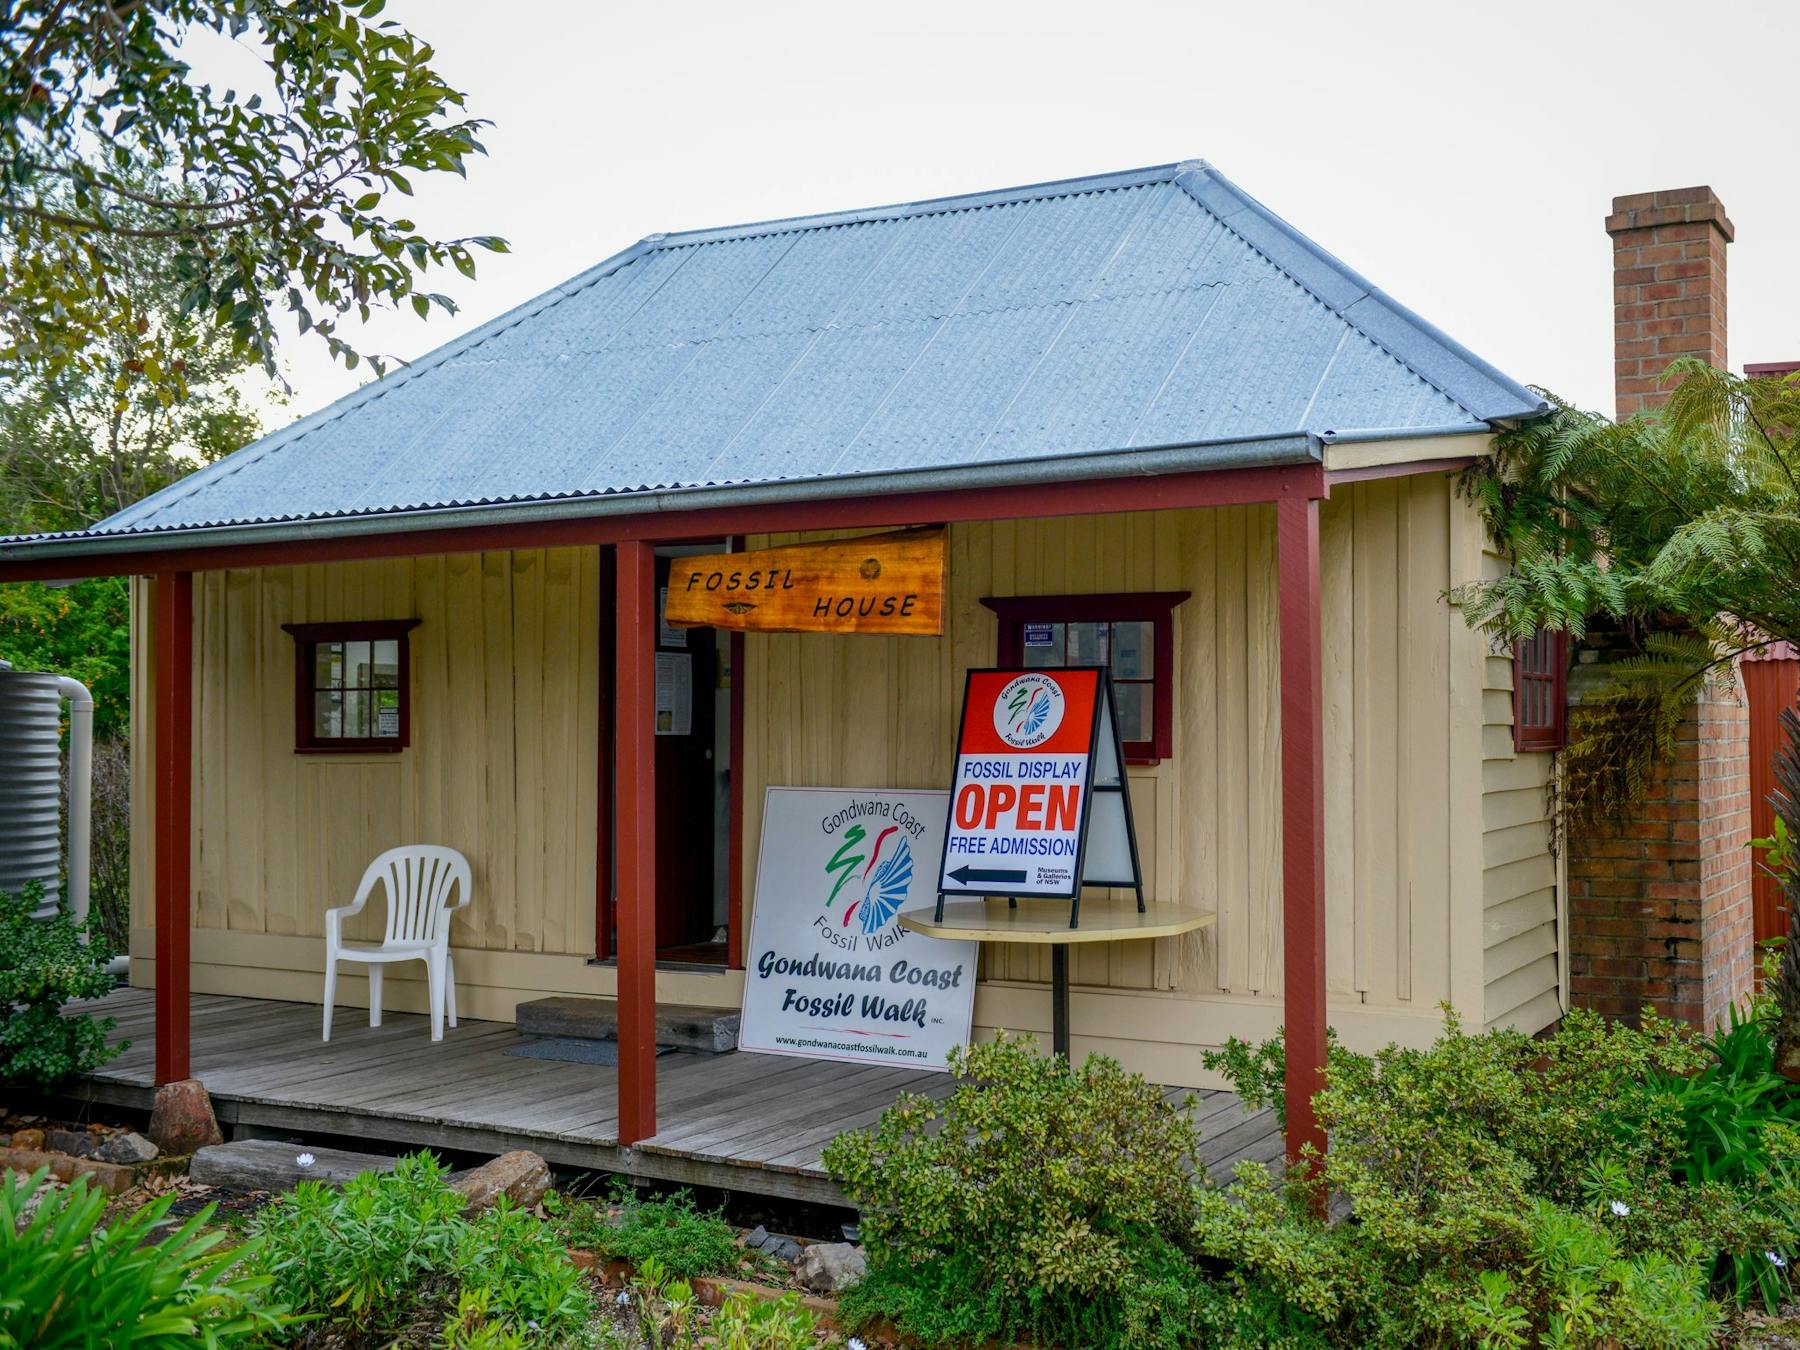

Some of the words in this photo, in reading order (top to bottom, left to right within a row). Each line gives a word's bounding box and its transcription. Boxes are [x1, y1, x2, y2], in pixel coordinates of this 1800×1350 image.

[686, 569, 795, 592] FOSSIL
[812, 594, 918, 617] HOUSE
[1001, 677, 1041, 700] Gondwana
[1042, 678, 1061, 697] Coast
[1005, 732, 1024, 746] Fossil
[963, 761, 1013, 778] FOSSIL
[1017, 761, 1081, 779] DISPLAY
[955, 783, 1080, 831] OPEN
[822, 799, 890, 835] Gondwana
[892, 802, 927, 840] Coast
[949, 836, 987, 854] FREE
[989, 837, 1076, 856] ADMISSION
[813, 915, 858, 952] Fossil
[867, 924, 911, 951] Walk
[757, 950, 881, 983] Gondwana
[889, 960, 963, 990] Coast
[781, 988, 853, 1018] Fossil
[861, 995, 927, 1028] Walk
[930, 1017, 945, 1025] INC.
[775, 1035, 928, 1059] www.gondwanacoastfossilwalk.com.au
